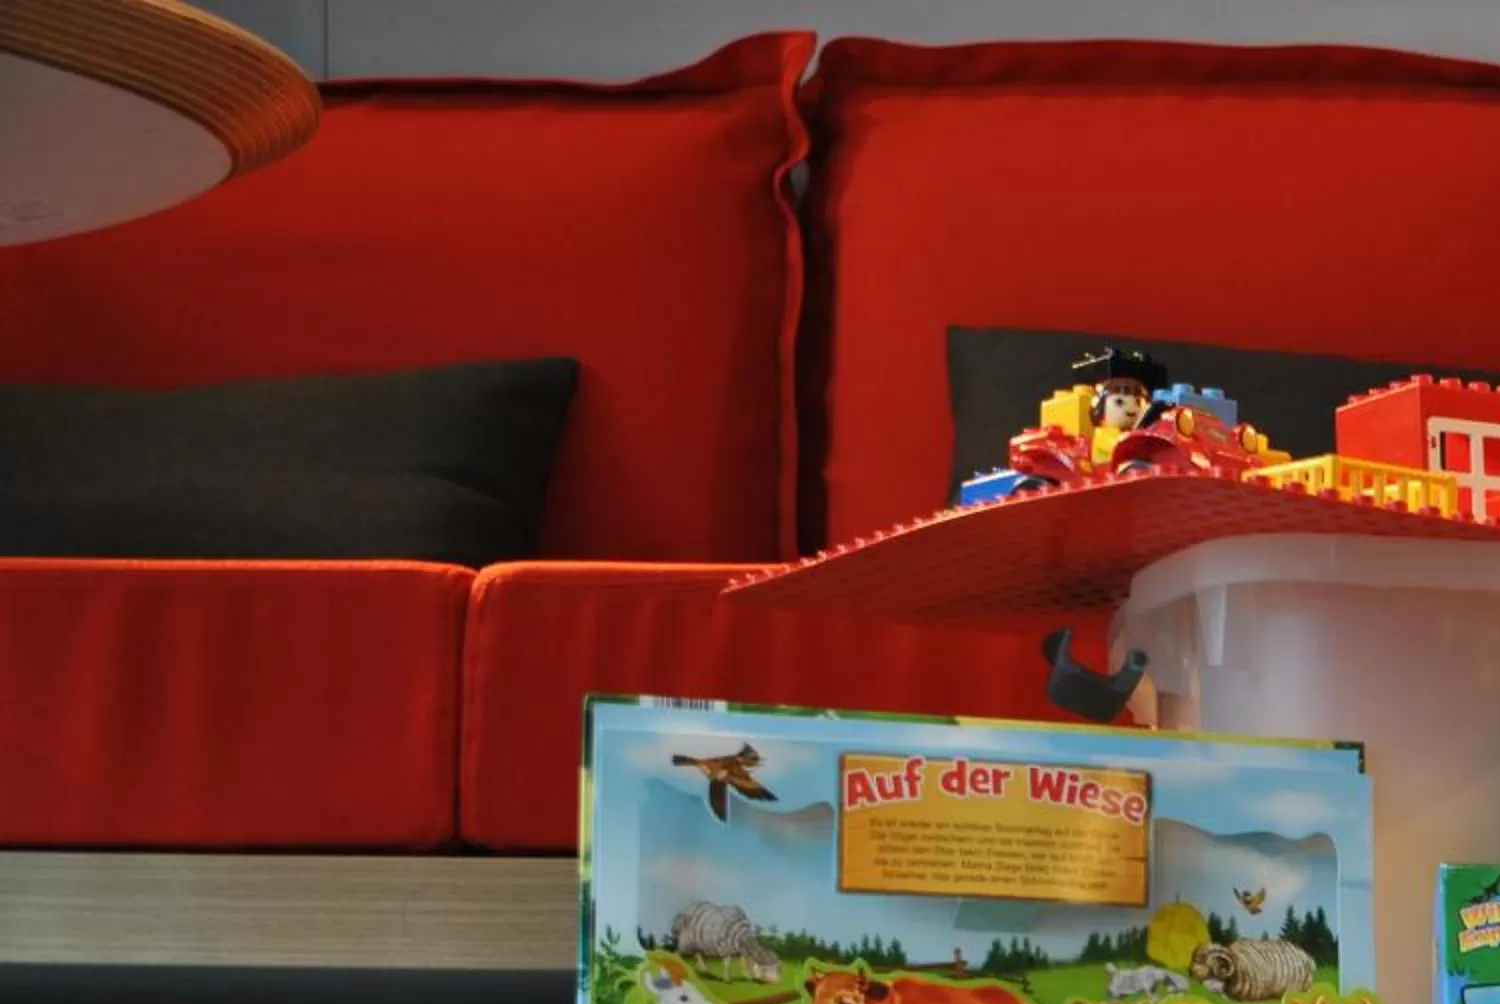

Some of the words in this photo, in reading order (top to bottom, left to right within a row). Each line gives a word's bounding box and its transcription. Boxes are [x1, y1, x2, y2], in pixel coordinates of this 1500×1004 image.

[846, 757, 924, 809] Auf
[940, 759, 1011, 797] der
[1028, 766, 1147, 823] Wiese
